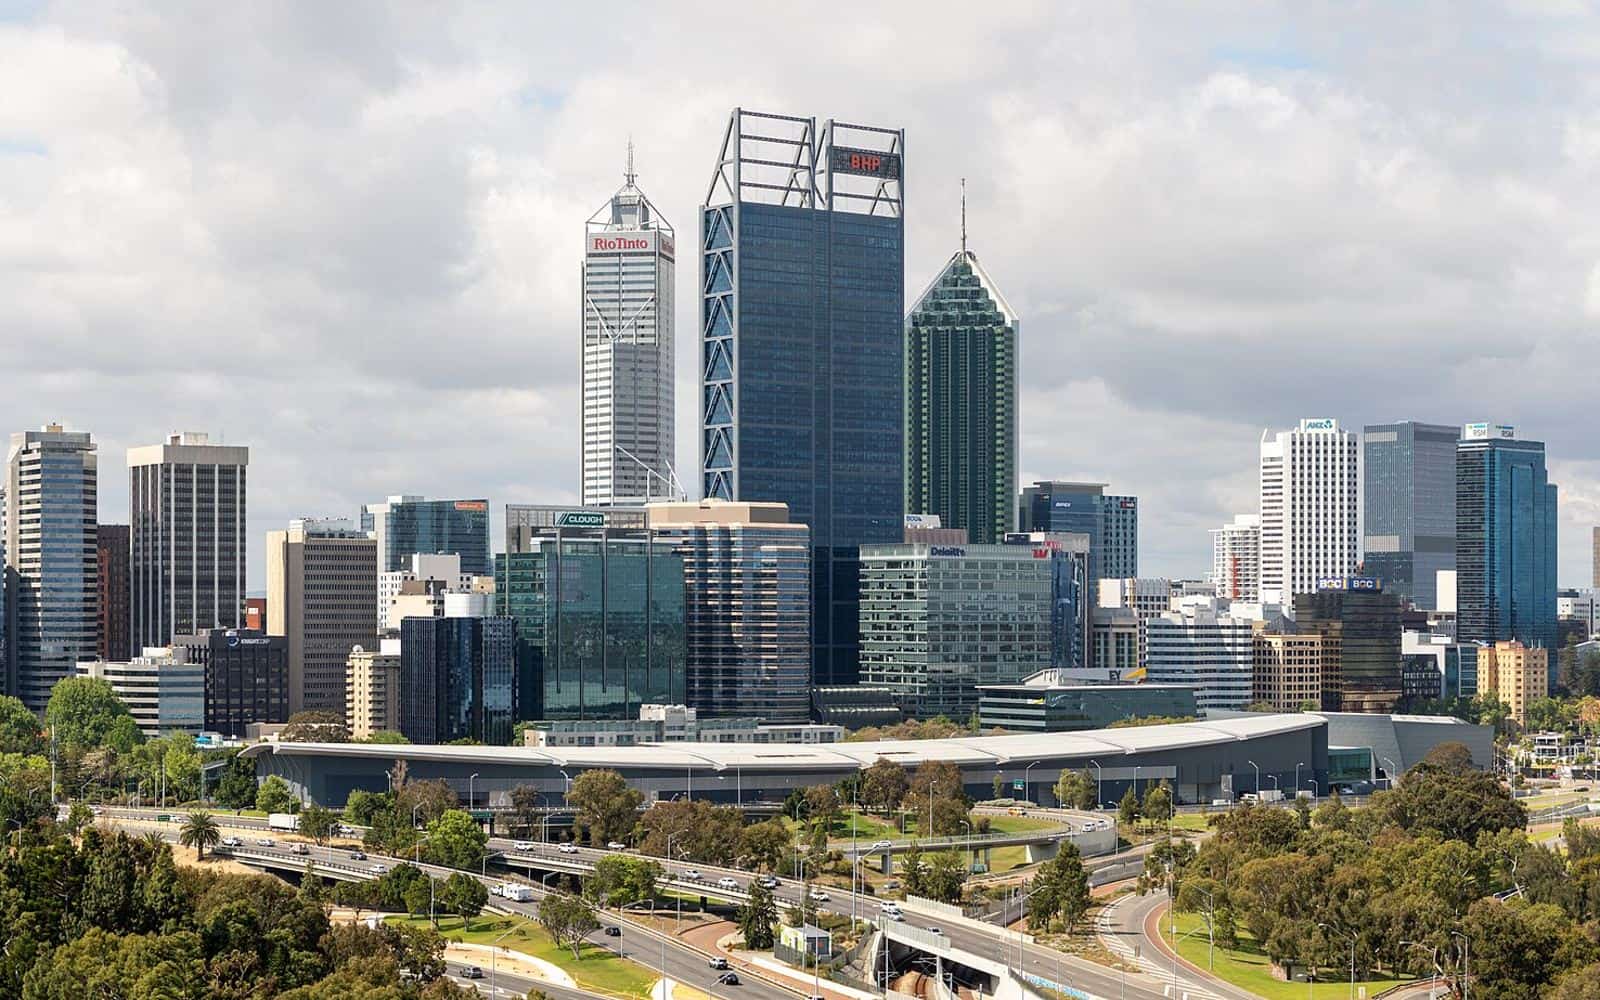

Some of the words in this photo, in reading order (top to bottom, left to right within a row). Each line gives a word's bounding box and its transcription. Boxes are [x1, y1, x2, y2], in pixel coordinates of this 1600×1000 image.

[851, 153, 880, 171] BHP
[1307, 421, 1324, 429] ANZ
[569, 515, 603, 524] CLOUGH
[931, 546, 966, 557] Deloitte
[1109, 670, 1121, 681] EY
